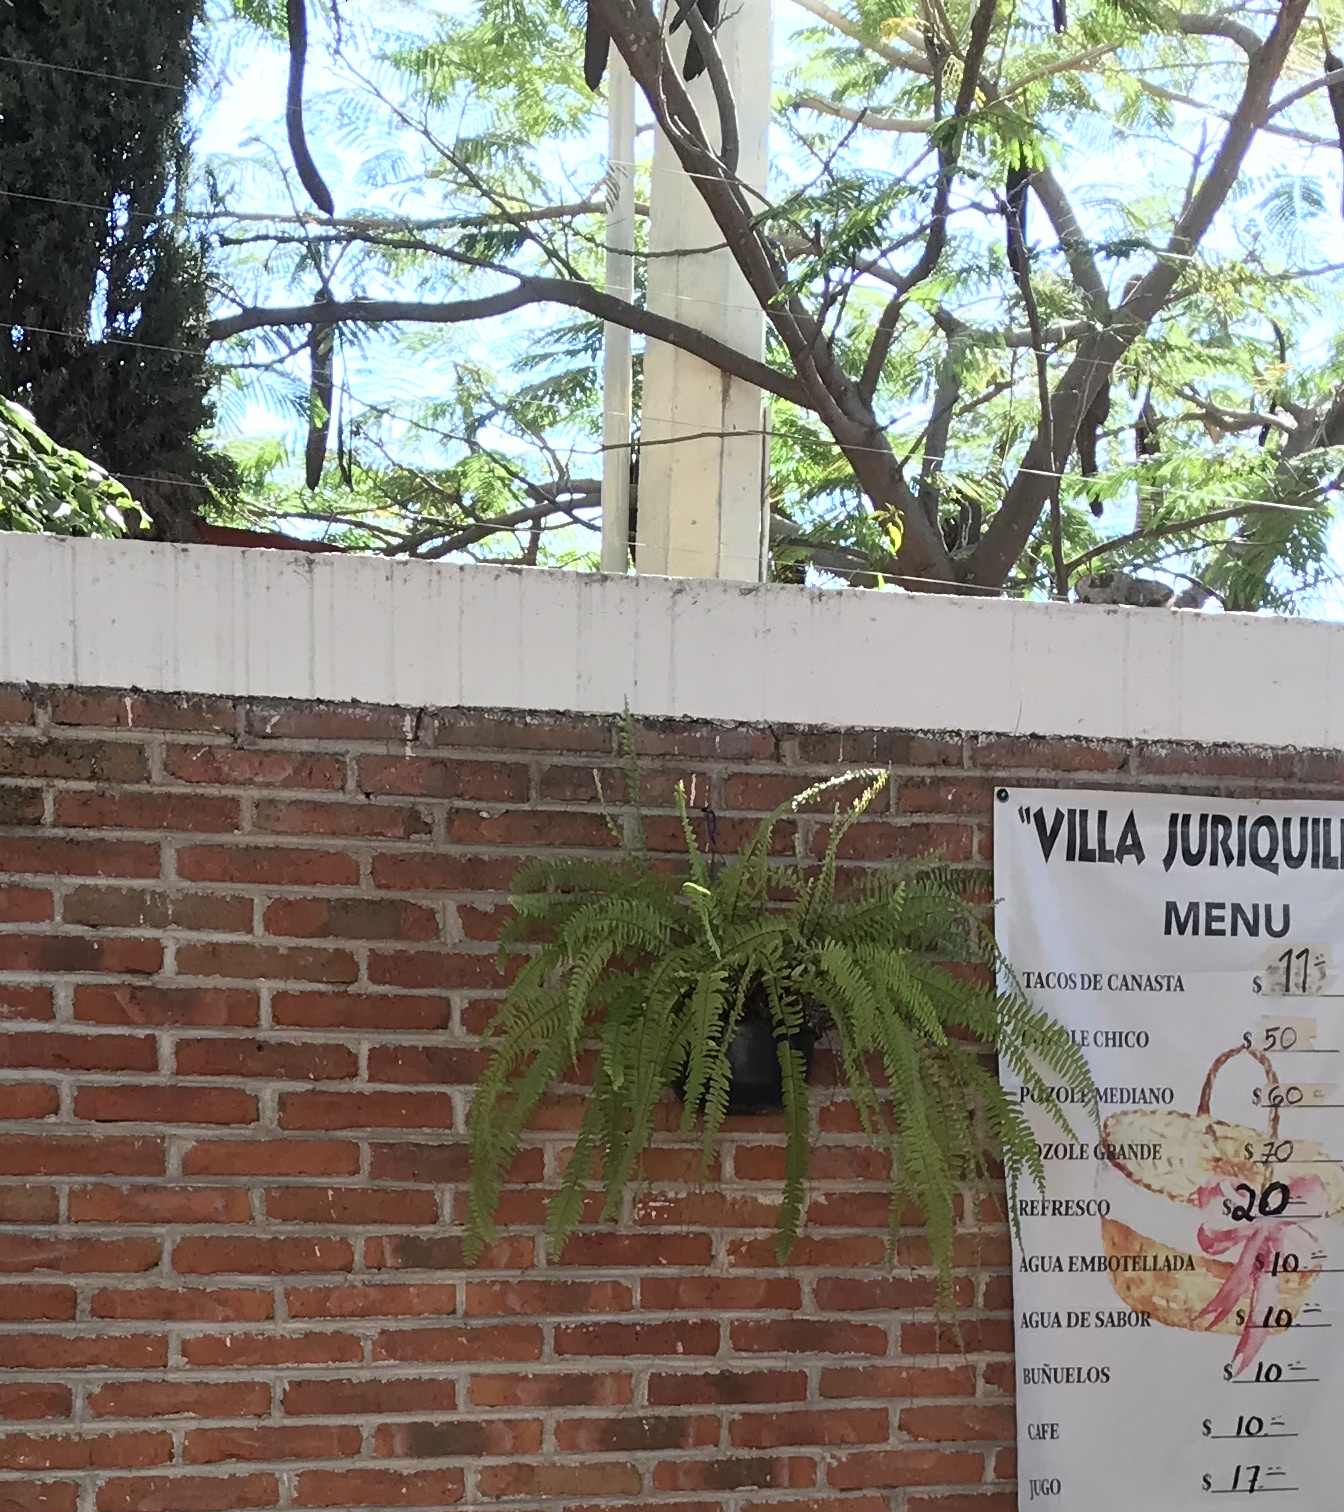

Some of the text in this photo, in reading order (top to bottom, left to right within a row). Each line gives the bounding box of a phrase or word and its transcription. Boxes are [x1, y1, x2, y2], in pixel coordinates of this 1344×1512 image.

[1163, 901, 1290, 937] MENU
[1022, 971, 1078, 991] TACOS
[1079, 973, 1103, 991] DE
[1107, 973, 1184, 992] CANASTA
[1093, 1030, 1150, 1048] CHICO
[1096, 1087, 1174, 1104] MEDIANO
[1036, 1143, 1089, 1160] ZOLE
[1094, 1143, 1162, 1161] GRANDE
[1019, 1199, 1110, 1216] REFRESCO
[1019, 1255, 1064, 1272] AGUA
[1068, 1255, 1195, 1272] EMBOTELLADA
[1020, 1311, 1062, 1328] AGUA
[1066, 1311, 1091, 1328] DE
[1094, 1310, 1152, 1328] SABOR
[1023, 1363, 1110, 1385] BUÑUELOS
[1028, 1423, 1059, 1440] CAFE
[1029, 1478, 1061, 1499] JUGO
